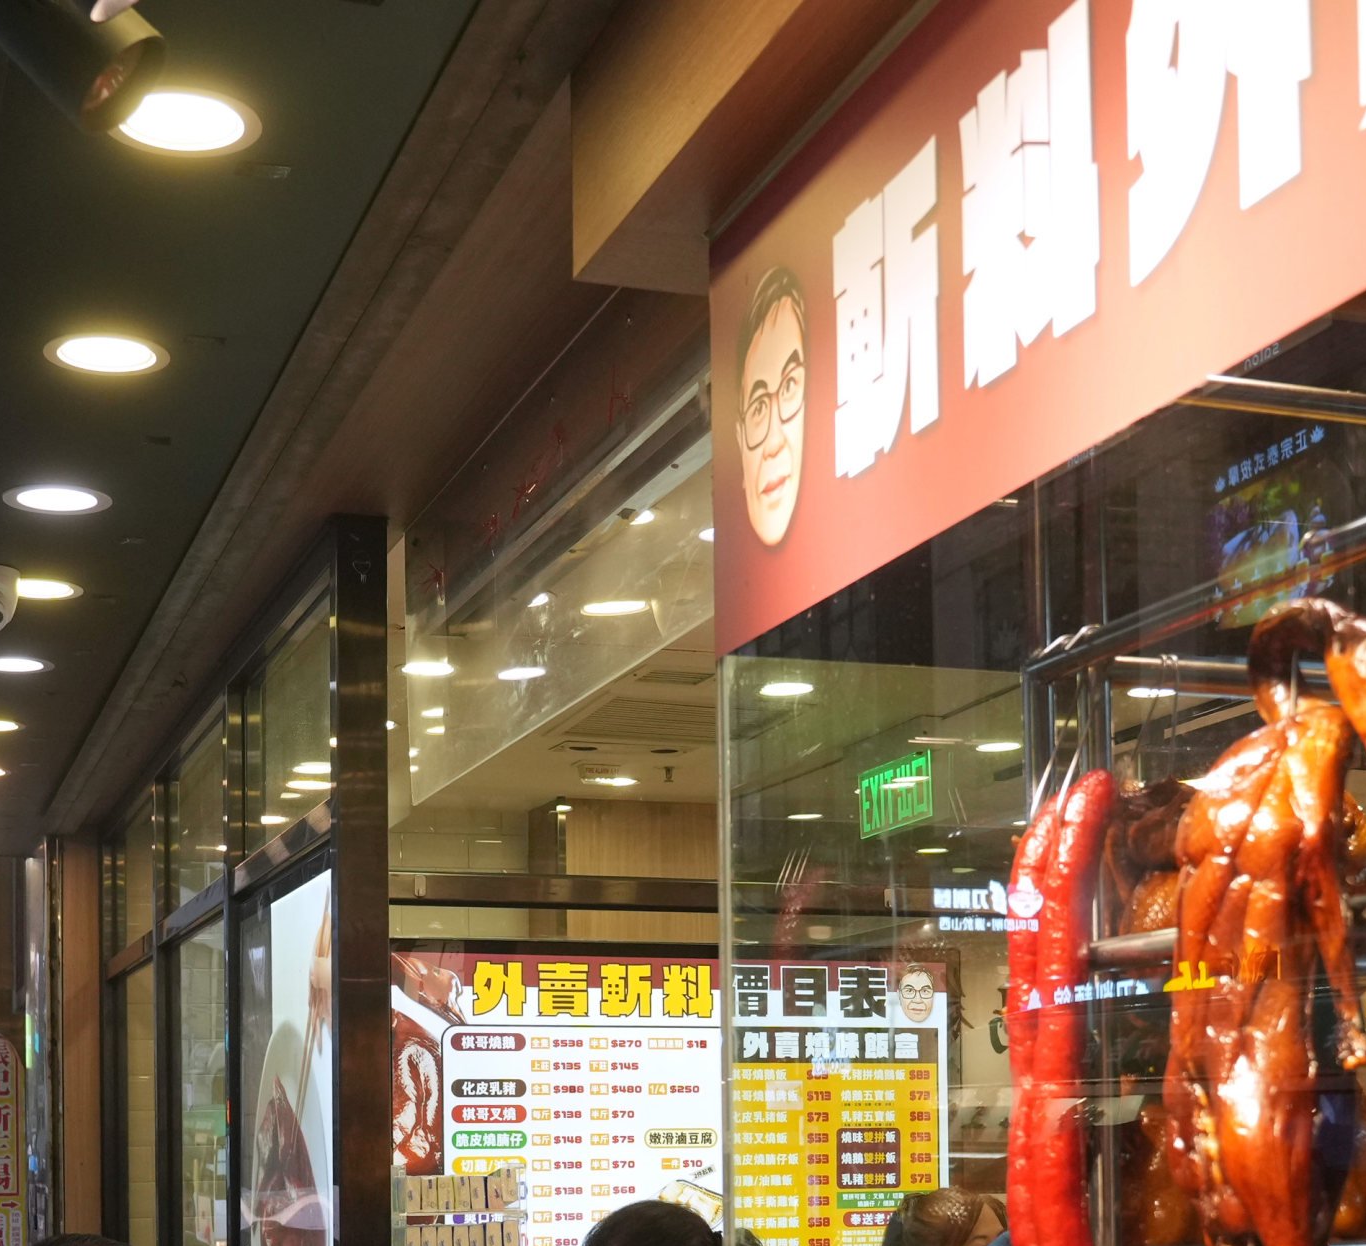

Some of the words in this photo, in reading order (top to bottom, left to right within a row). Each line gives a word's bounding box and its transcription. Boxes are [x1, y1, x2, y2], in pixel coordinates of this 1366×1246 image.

[861, 771, 894, 834] EXIT
[461, 1035, 515, 1050] 棋哥燒鵝
[553, 1039, 584, 1048] $538
[611, 1040, 642, 1049] $270
[553, 1062, 581, 1071] $135
[611, 1062, 639, 1071] $145
[462, 1082, 516, 1095] 化皮乳豬
[611, 1085, 642, 1094] $480
[669, 1085, 700, 1094] $250
[462, 1107, 516, 1121] 棋哥叉燒
[554, 1110, 582, 1119] $138
[612, 1110, 635, 1119] $70
[554, 1135, 582, 1145] $148
[612, 1135, 635, 1145] $75
[554, 1160, 583, 1170] $138
[612, 1160, 635, 1169] $70
[682, 1159, 703, 1168] $10
[555, 1186, 583, 1196] $138
[612, 1186, 636, 1195] $68
[555, 1212, 583, 1222] $158
[555, 1238, 578, 1246] $80
